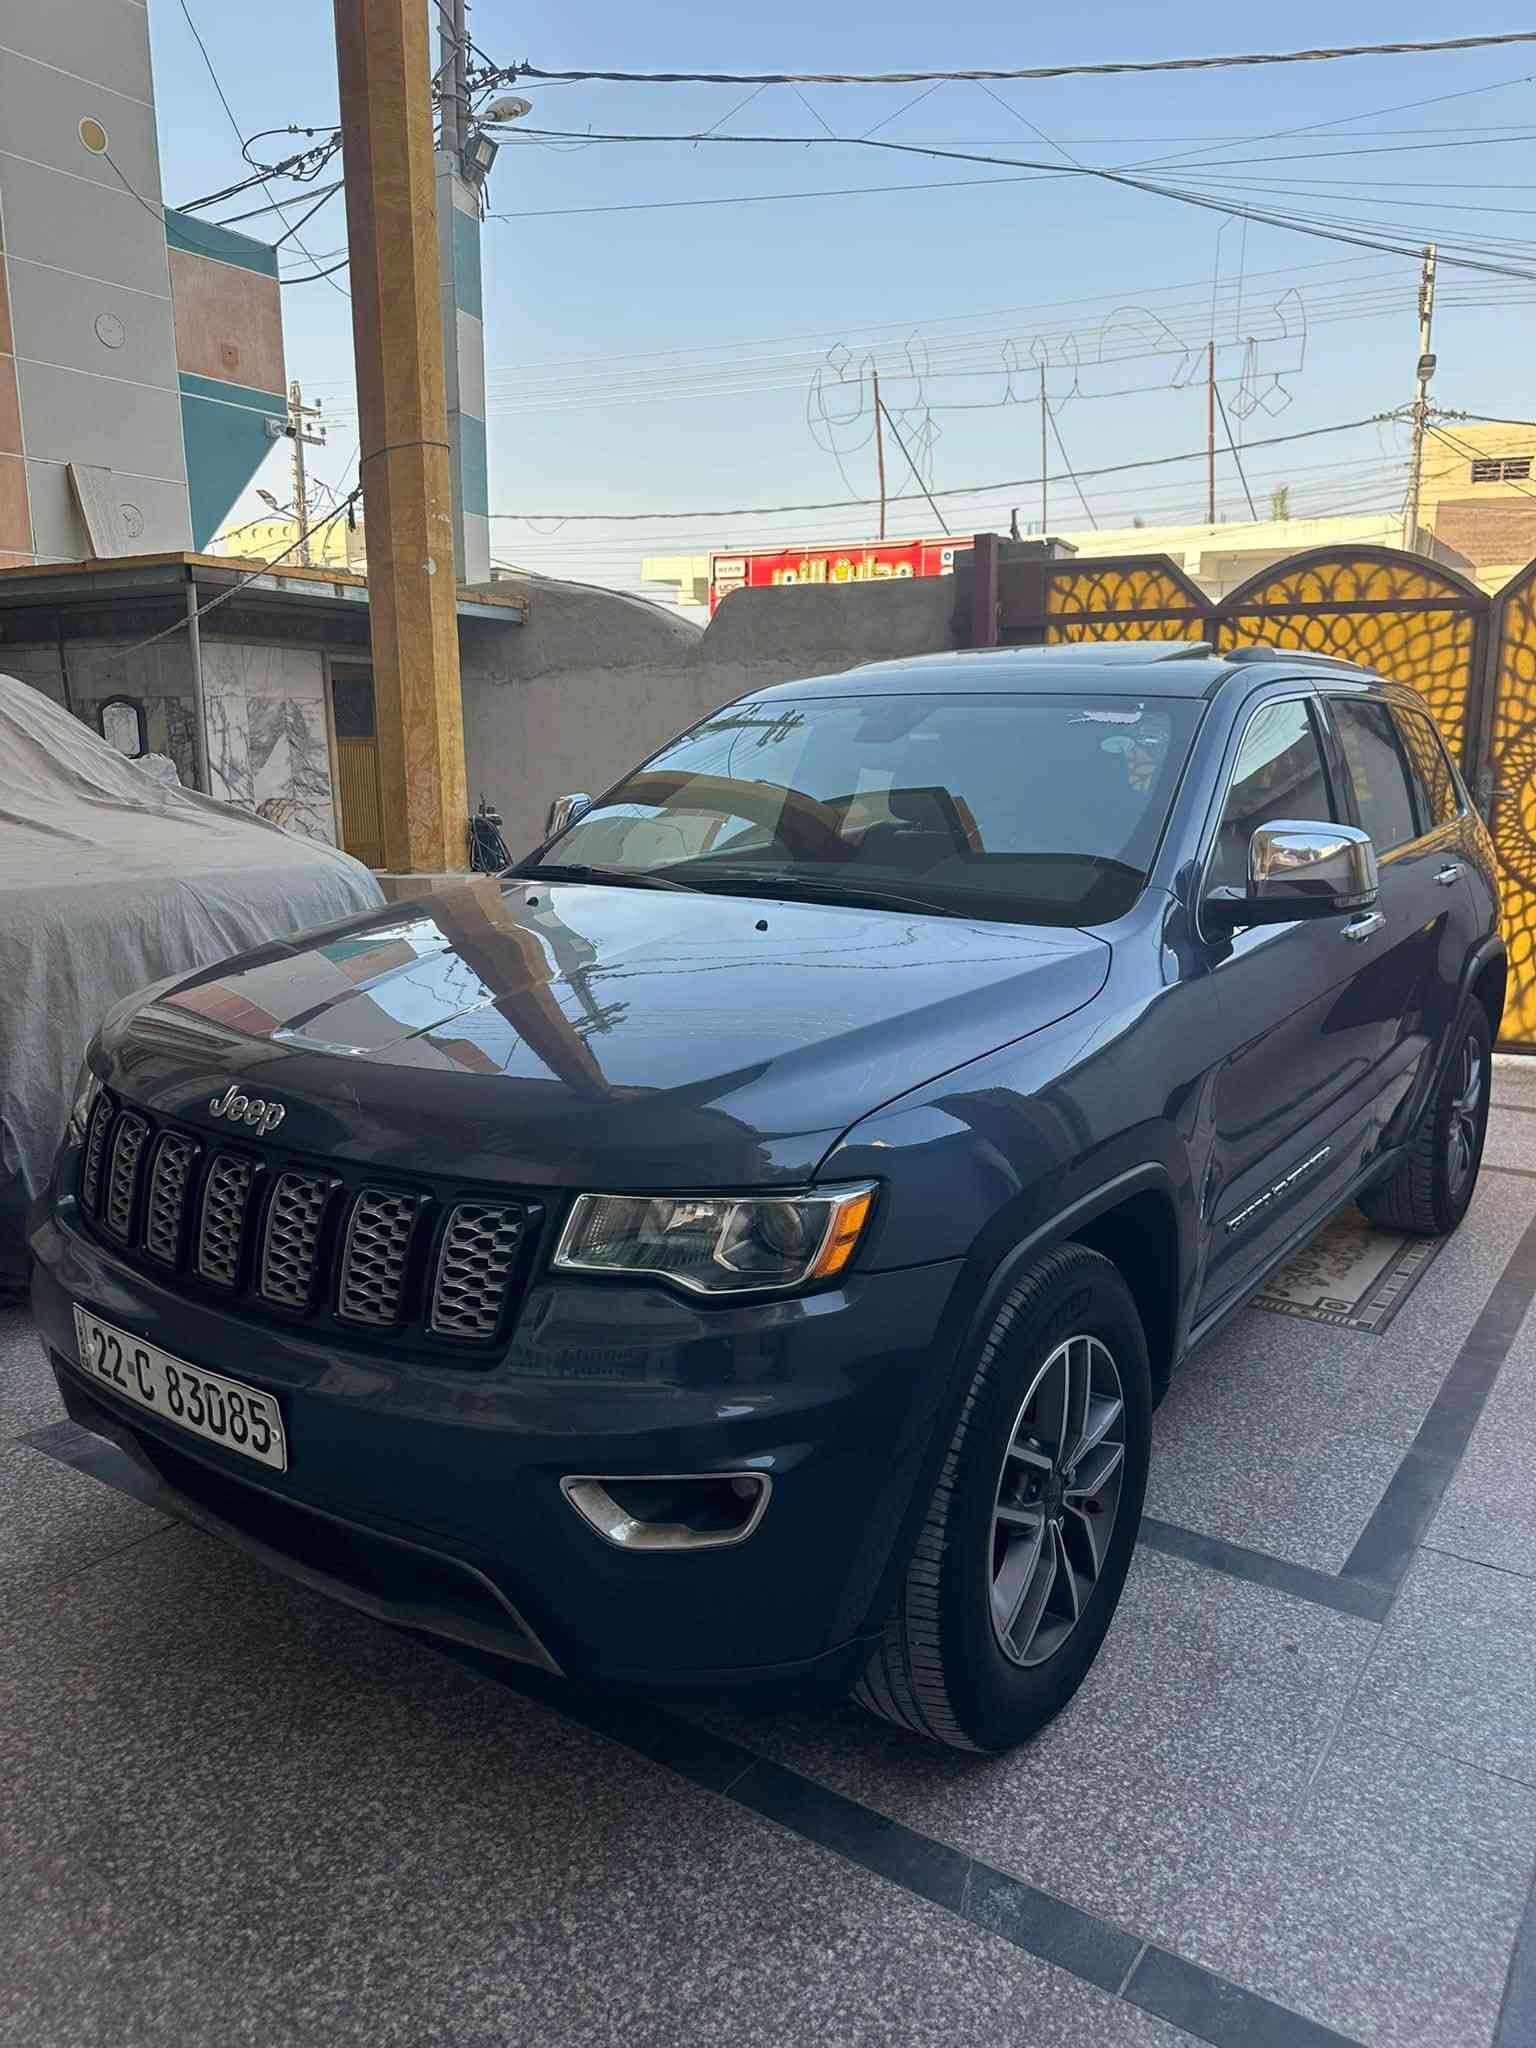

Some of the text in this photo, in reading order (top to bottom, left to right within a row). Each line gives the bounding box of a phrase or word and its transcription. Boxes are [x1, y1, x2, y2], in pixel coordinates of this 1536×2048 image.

[208, 1085, 285, 1136] Jeep
[93, 1328, 128, 1389] 22
[135, 1349, 156, 1401] C
[166, 1365, 272, 1454] 83085
